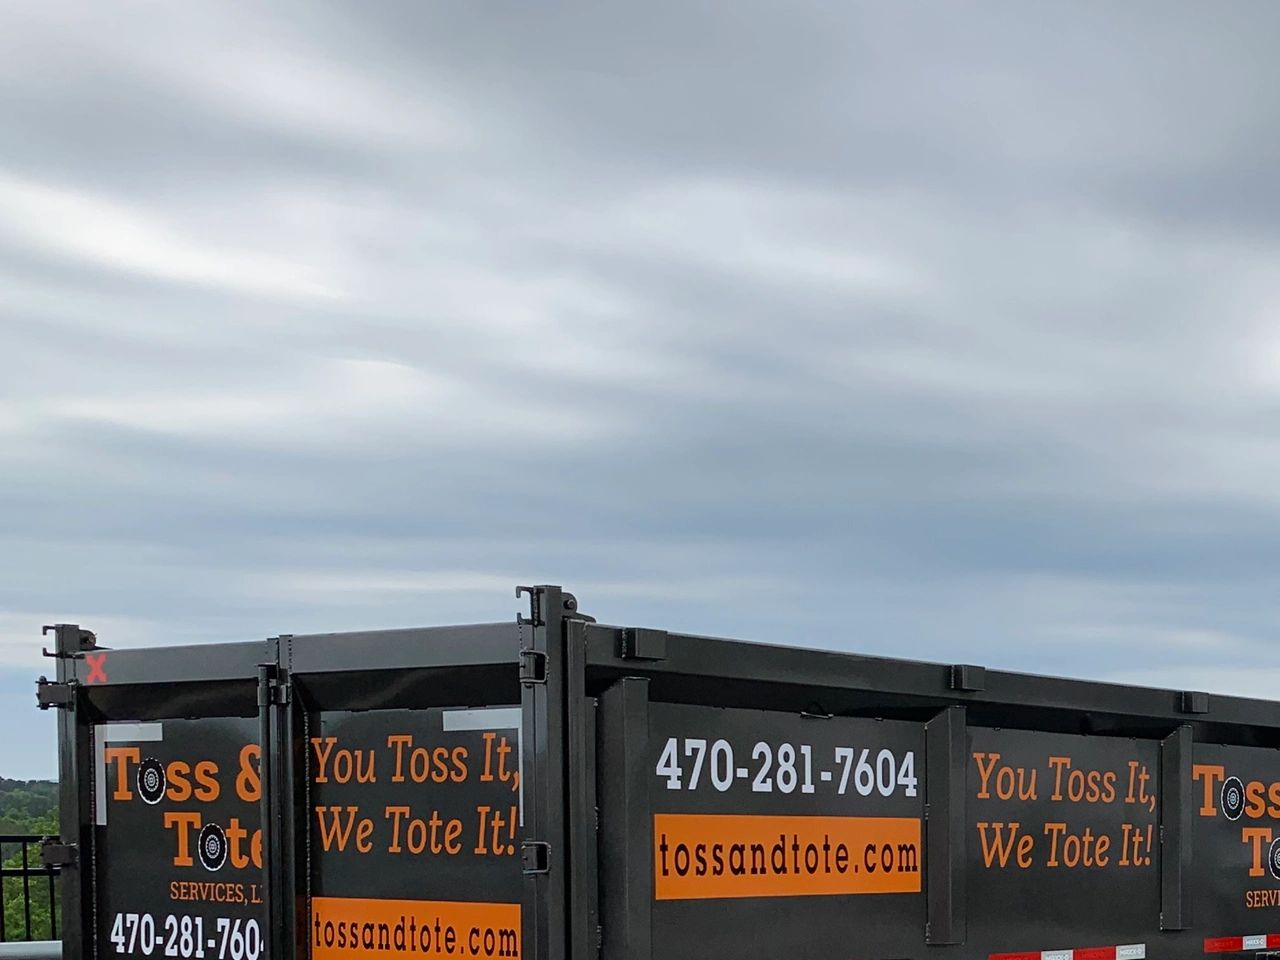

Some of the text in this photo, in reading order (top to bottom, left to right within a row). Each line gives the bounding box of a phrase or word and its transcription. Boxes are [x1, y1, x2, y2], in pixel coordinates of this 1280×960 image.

[85, 654, 108, 684] X
[235, 743, 262, 803] &
[310, 732, 520, 792] You Toss It,
[655, 737, 918, 797] 470-281-7604
[972, 752, 1156, 813] You Toss It,
[315, 806, 517, 856] We Tote It!
[659, 833, 919, 877] tossandtote.com
[976, 822, 1153, 869] We Tote It!
[169, 880, 248, 906] SERVICES,
[314, 912, 519, 957] tossandtote.com
